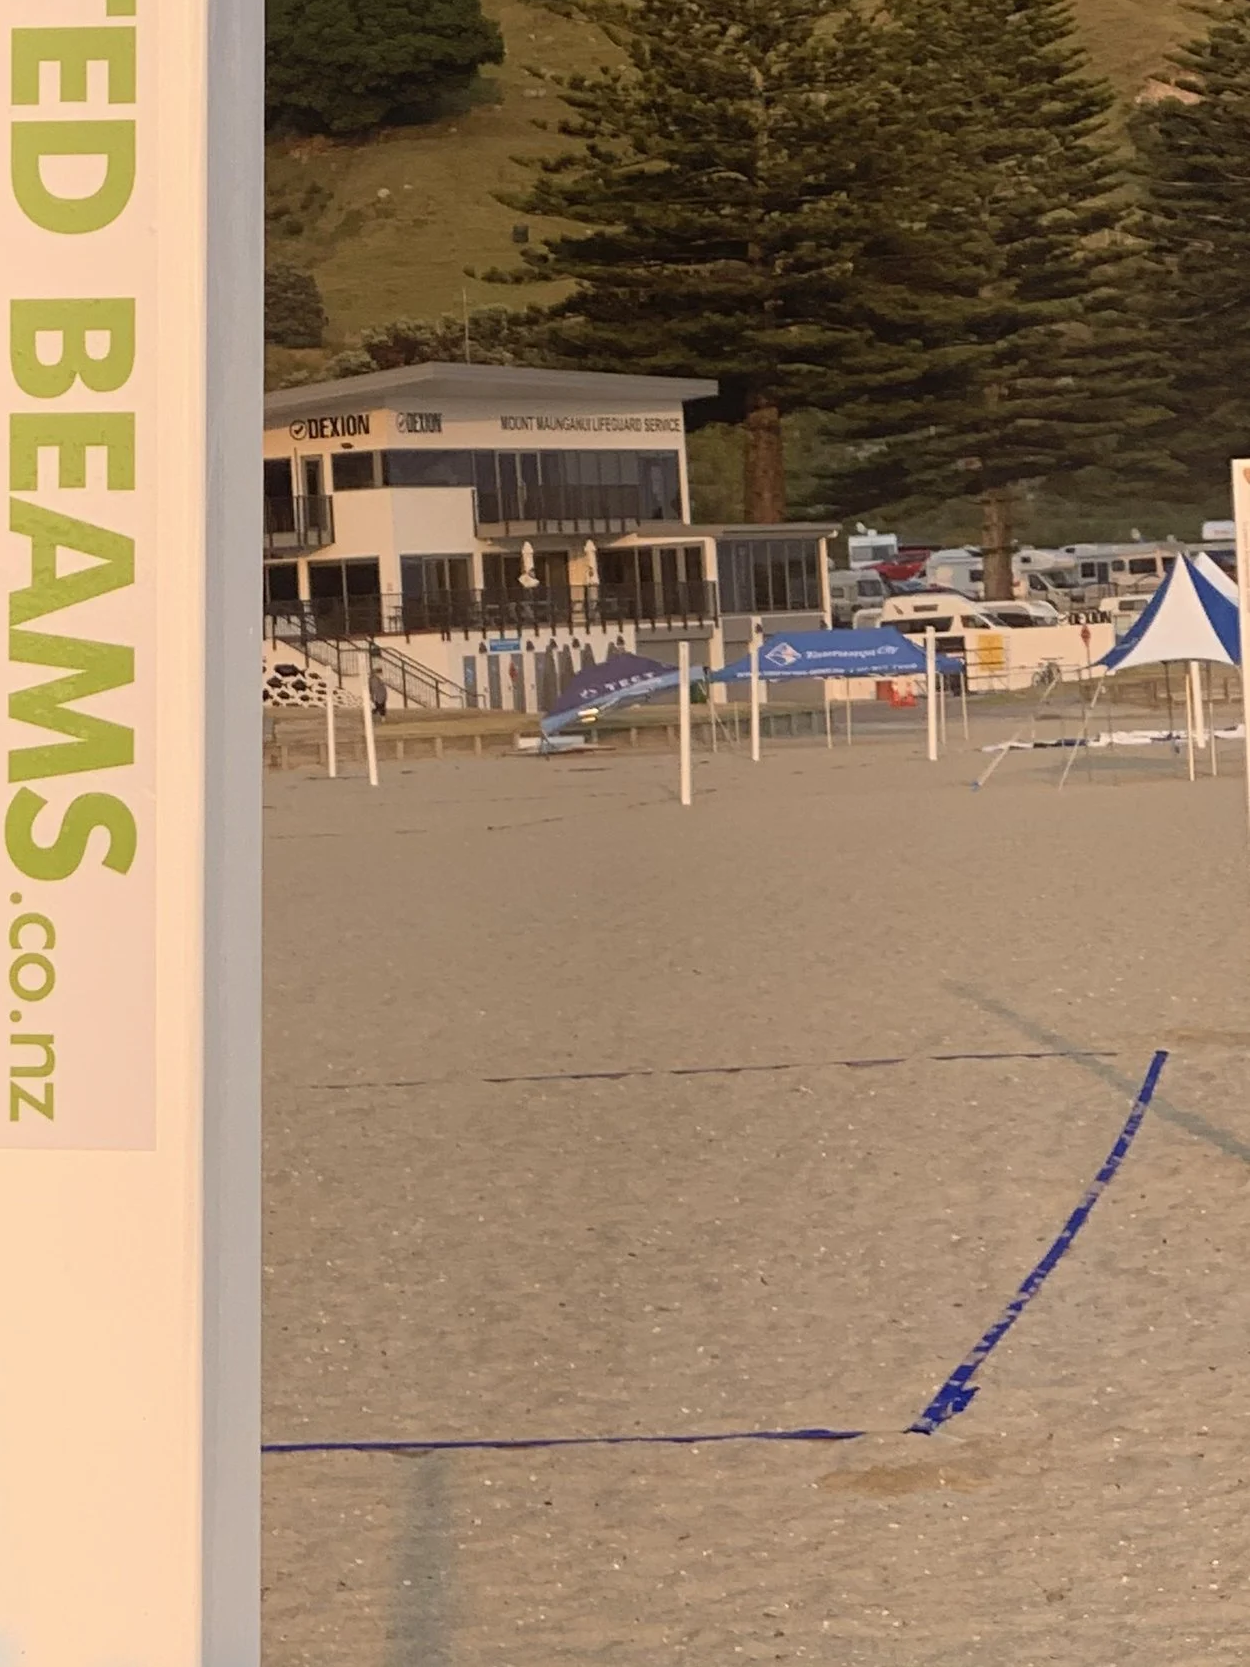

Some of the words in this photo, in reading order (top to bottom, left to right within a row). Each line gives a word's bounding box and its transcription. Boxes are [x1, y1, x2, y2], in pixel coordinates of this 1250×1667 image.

[308, 414, 370, 439] DEXION
[407, 412, 443, 433] DEXION
[500, 415, 534, 430] MOUNT
[644, 417, 680, 432] SERVICE
